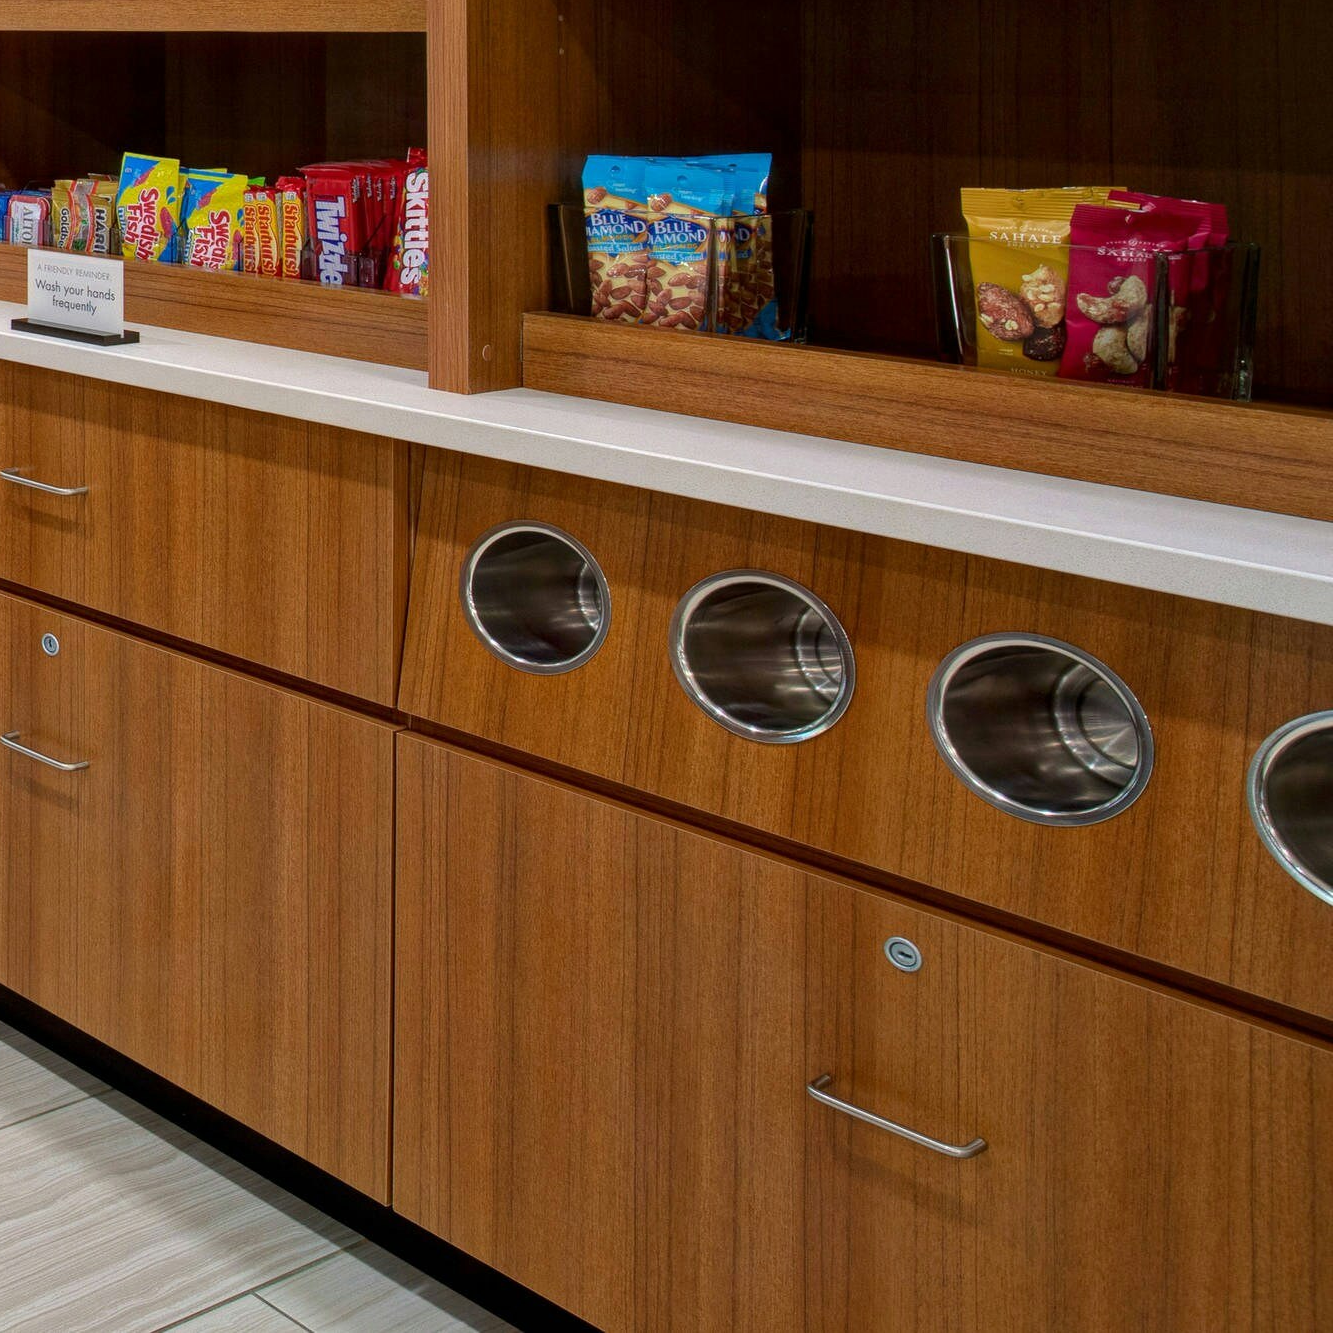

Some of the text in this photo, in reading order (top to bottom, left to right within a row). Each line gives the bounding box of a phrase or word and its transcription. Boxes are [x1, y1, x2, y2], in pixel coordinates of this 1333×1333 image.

[124, 203, 143, 244] Fish
[136, 187, 160, 261] Swedish
[401, 171, 428, 285] Skittles
[586, 220, 647, 238] IAMOND
[591, 211, 628, 226] BLUE
[654, 220, 693, 234] BLUE
[190, 225, 211, 267] Fish
[283, 203, 301, 276] Starburst
[314, 196, 348, 285] Twizzle
[989, 231, 1063, 245] SAHALE
[44, 264, 73, 276] FRIENDLY
[35, 278, 116, 301] Wash your hands
[52, 295, 98, 316] frequently
[1010, 367, 1048, 377] HONEY
